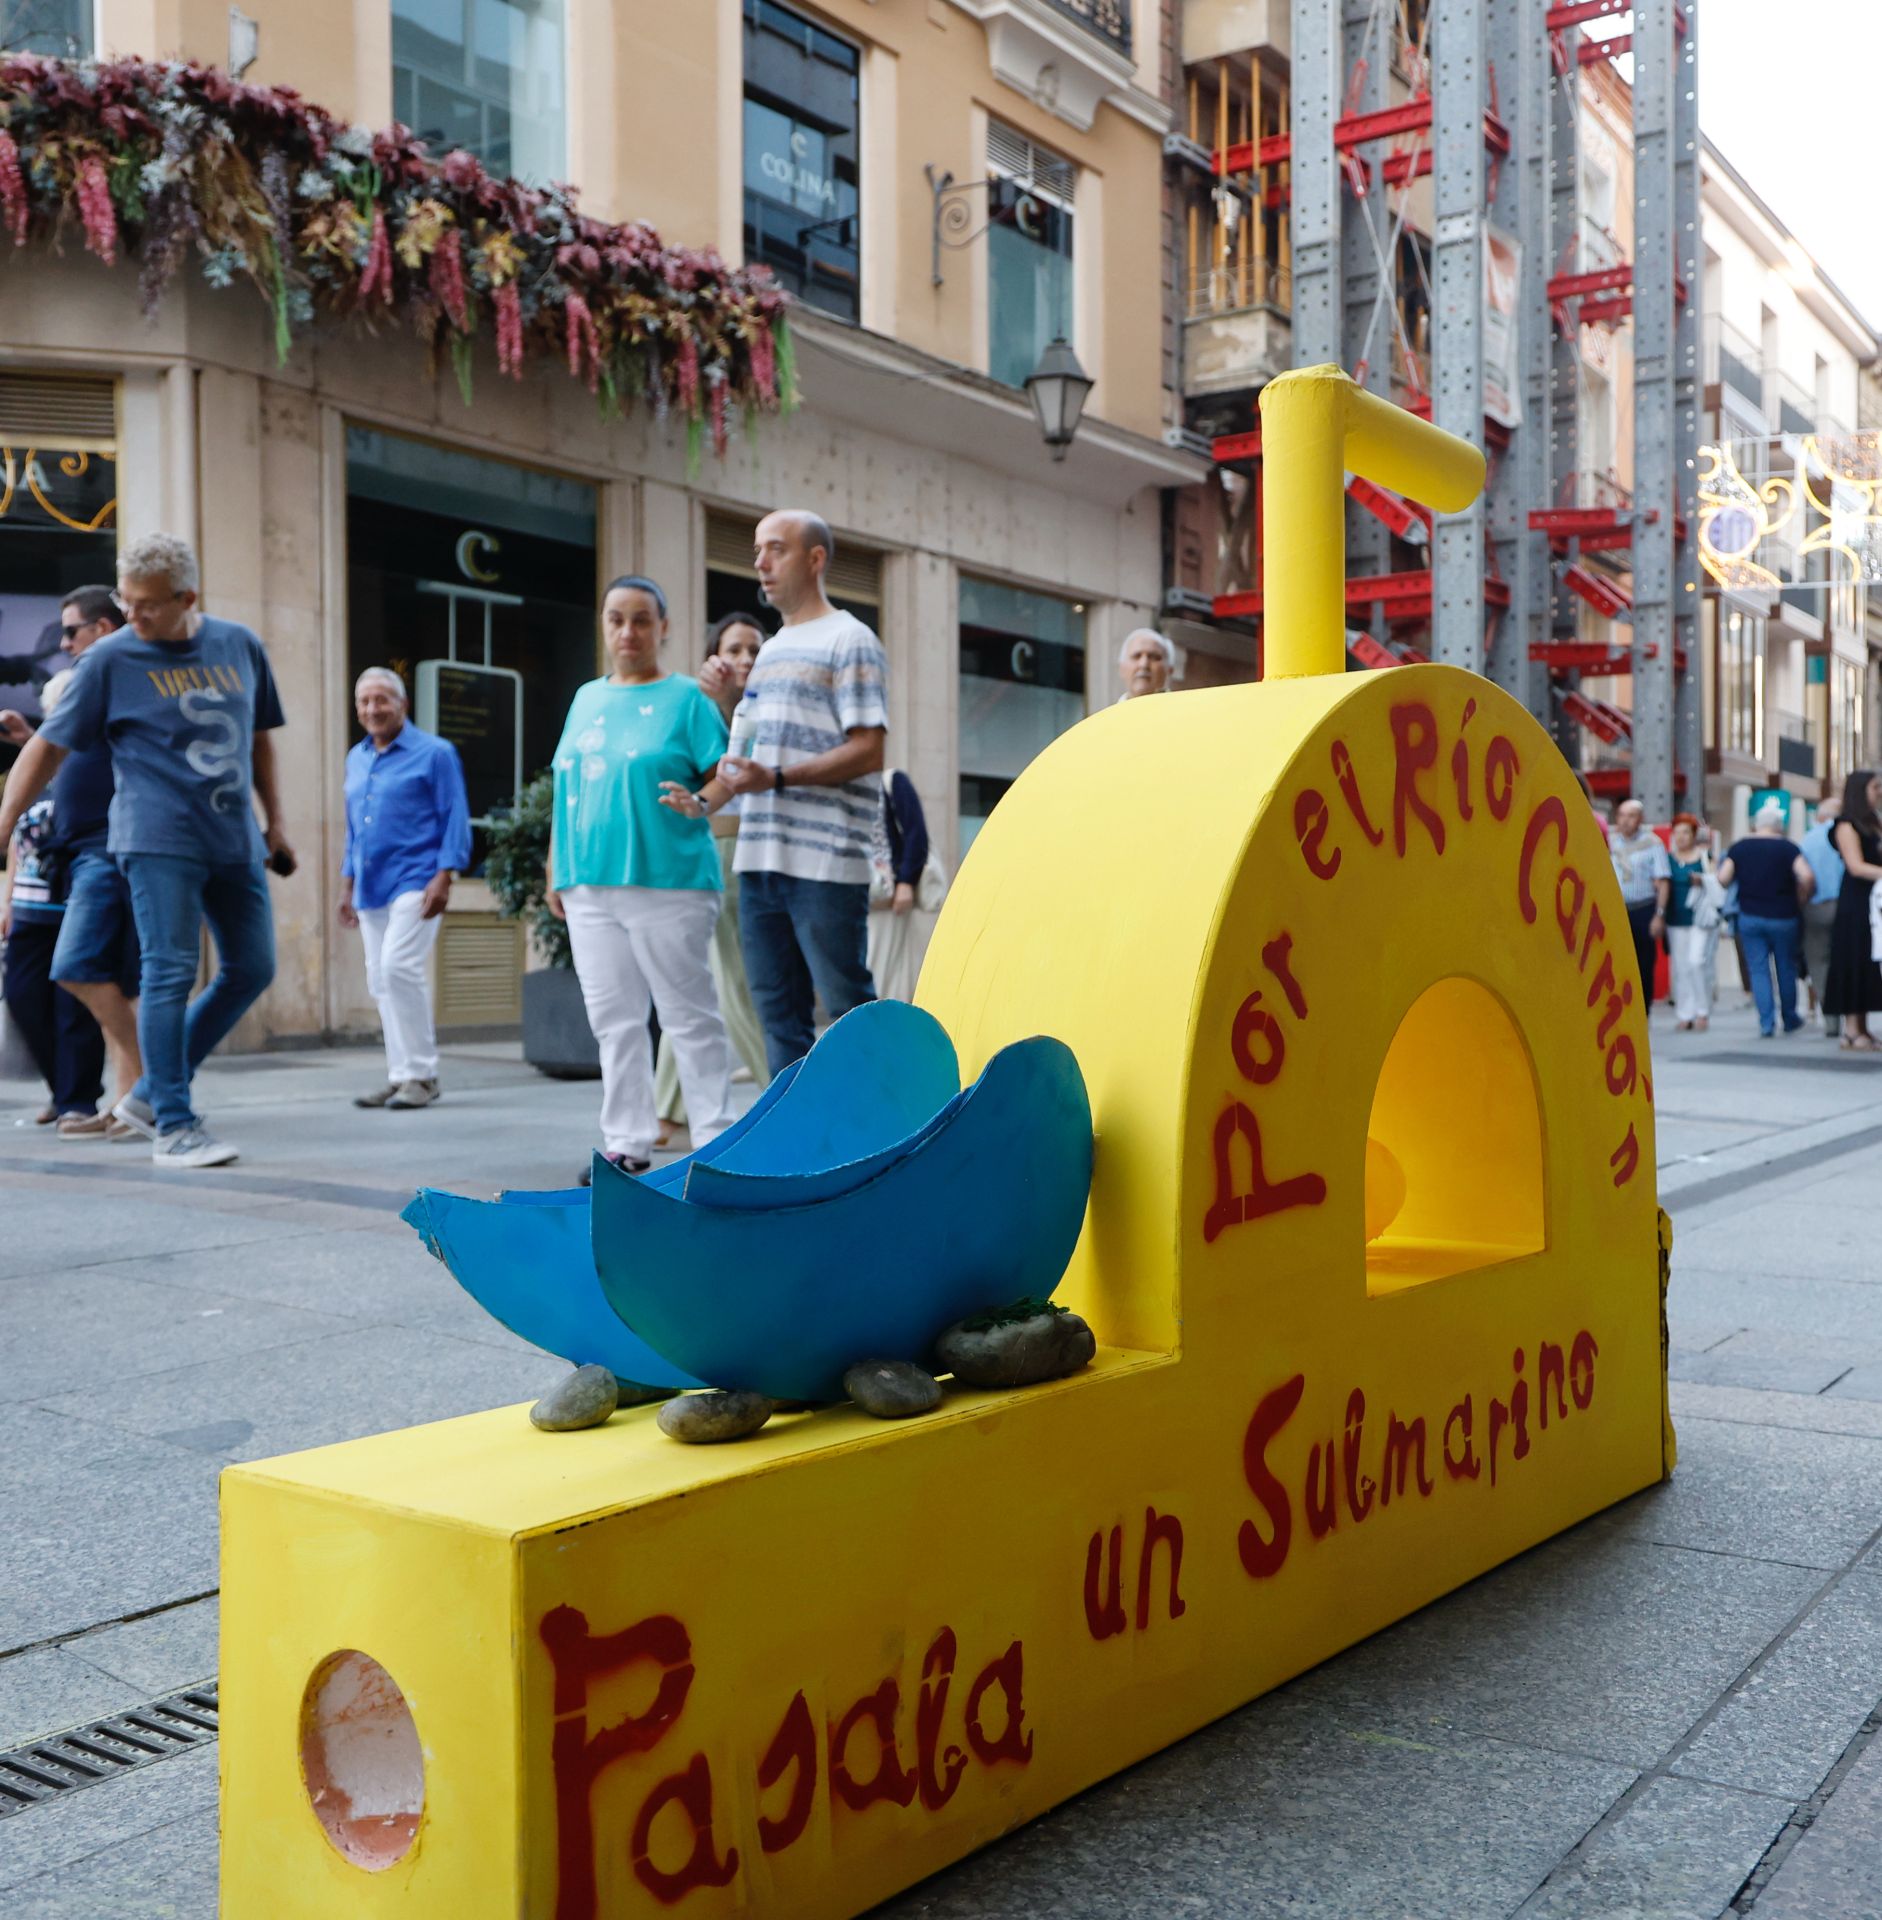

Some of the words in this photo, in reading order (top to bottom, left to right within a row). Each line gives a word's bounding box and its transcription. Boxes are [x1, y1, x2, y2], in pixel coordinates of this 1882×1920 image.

[760, 152, 836, 205] COLINA
[791, 132, 808, 158] C
[1203, 929, 1327, 1245] Por
[1294, 740, 1384, 880] el
[1390, 697, 1519, 858] Río
[1083, 1506, 1186, 1643] un
[1238, 1330, 1598, 1580] Submarino
